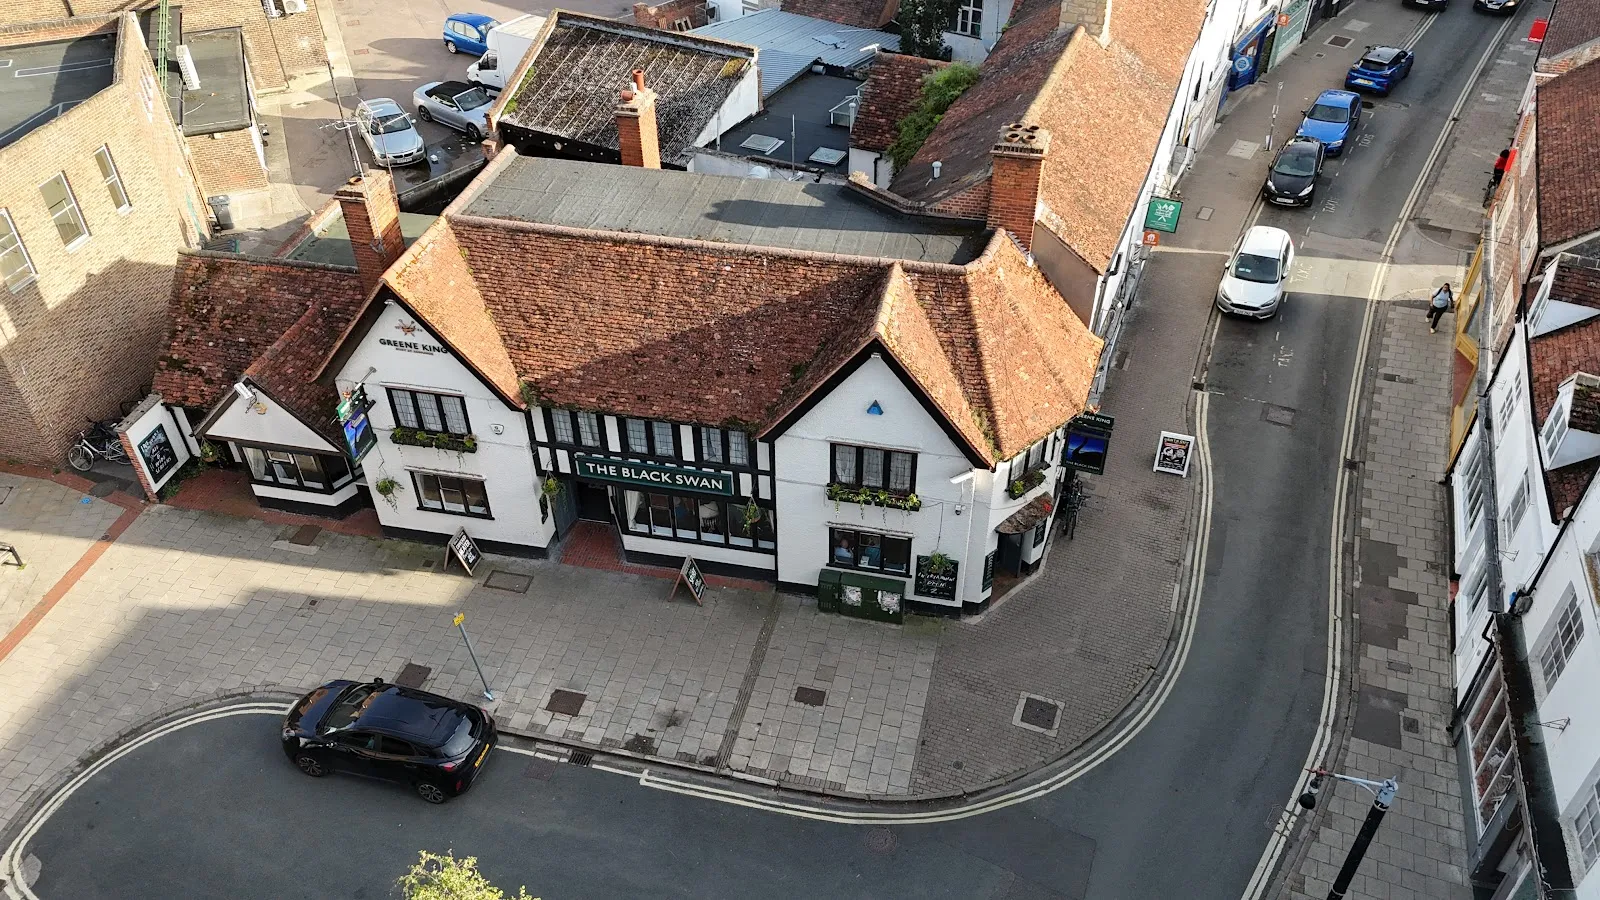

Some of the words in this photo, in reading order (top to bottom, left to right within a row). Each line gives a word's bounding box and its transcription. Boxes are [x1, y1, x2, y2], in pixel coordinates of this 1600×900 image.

[378, 338, 419, 350] GREENE
[421, 344, 448, 354] KING
[586, 462, 617, 476] THE
[621, 467, 673, 484] BLACK
[675, 474, 723, 490] SWAN
